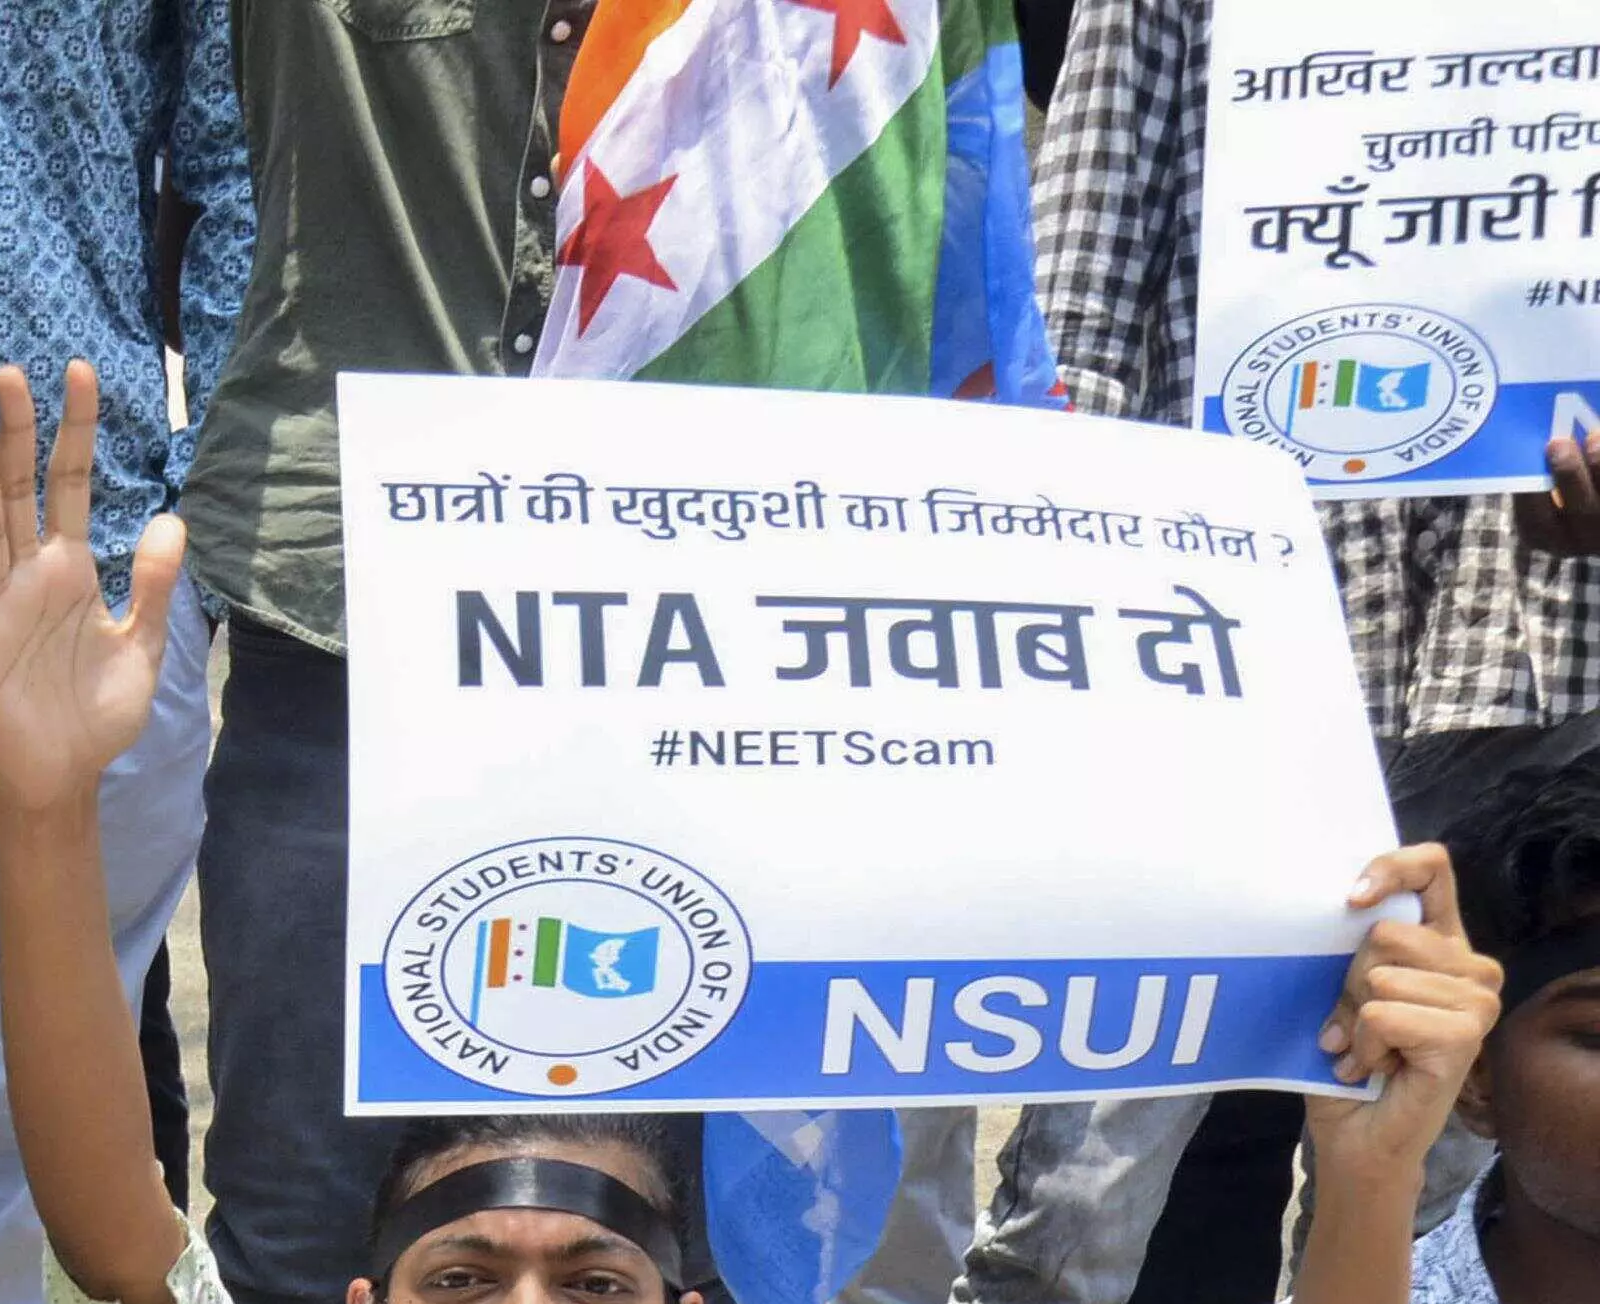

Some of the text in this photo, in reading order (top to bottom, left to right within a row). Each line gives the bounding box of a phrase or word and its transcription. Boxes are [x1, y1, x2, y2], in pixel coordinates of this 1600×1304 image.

[1232, 51, 1416, 102] आखिर
[1361, 116, 1499, 172] चुनावी
[1378, 173, 1558, 245] जारी
[1417, 321, 1484, 377] UNION
[1235, 378, 1315, 467] NIONAL
[1462, 383, 1484, 412] OF
[1394, 416, 1470, 463] INDIA
[381, 472, 511, 523] छात्रों
[519, 473, 595, 524] की
[605, 481, 827, 541] खुदकुशी
[839, 495, 909, 532] का
[919, 488, 1143, 548] जिम्मेदार
[1154, 511, 1257, 563] कौन
[456, 585, 1242, 698] NTA जवाब दो
[650, 730, 993, 766] #NEETScam
[640, 866, 731, 951] UNION
[402, 941, 511, 1075] NATIONAL
[702, 961, 732, 1002] OF
[615, 1008, 713, 1071] INDIA
[819, 973, 1220, 1076] NSUI
